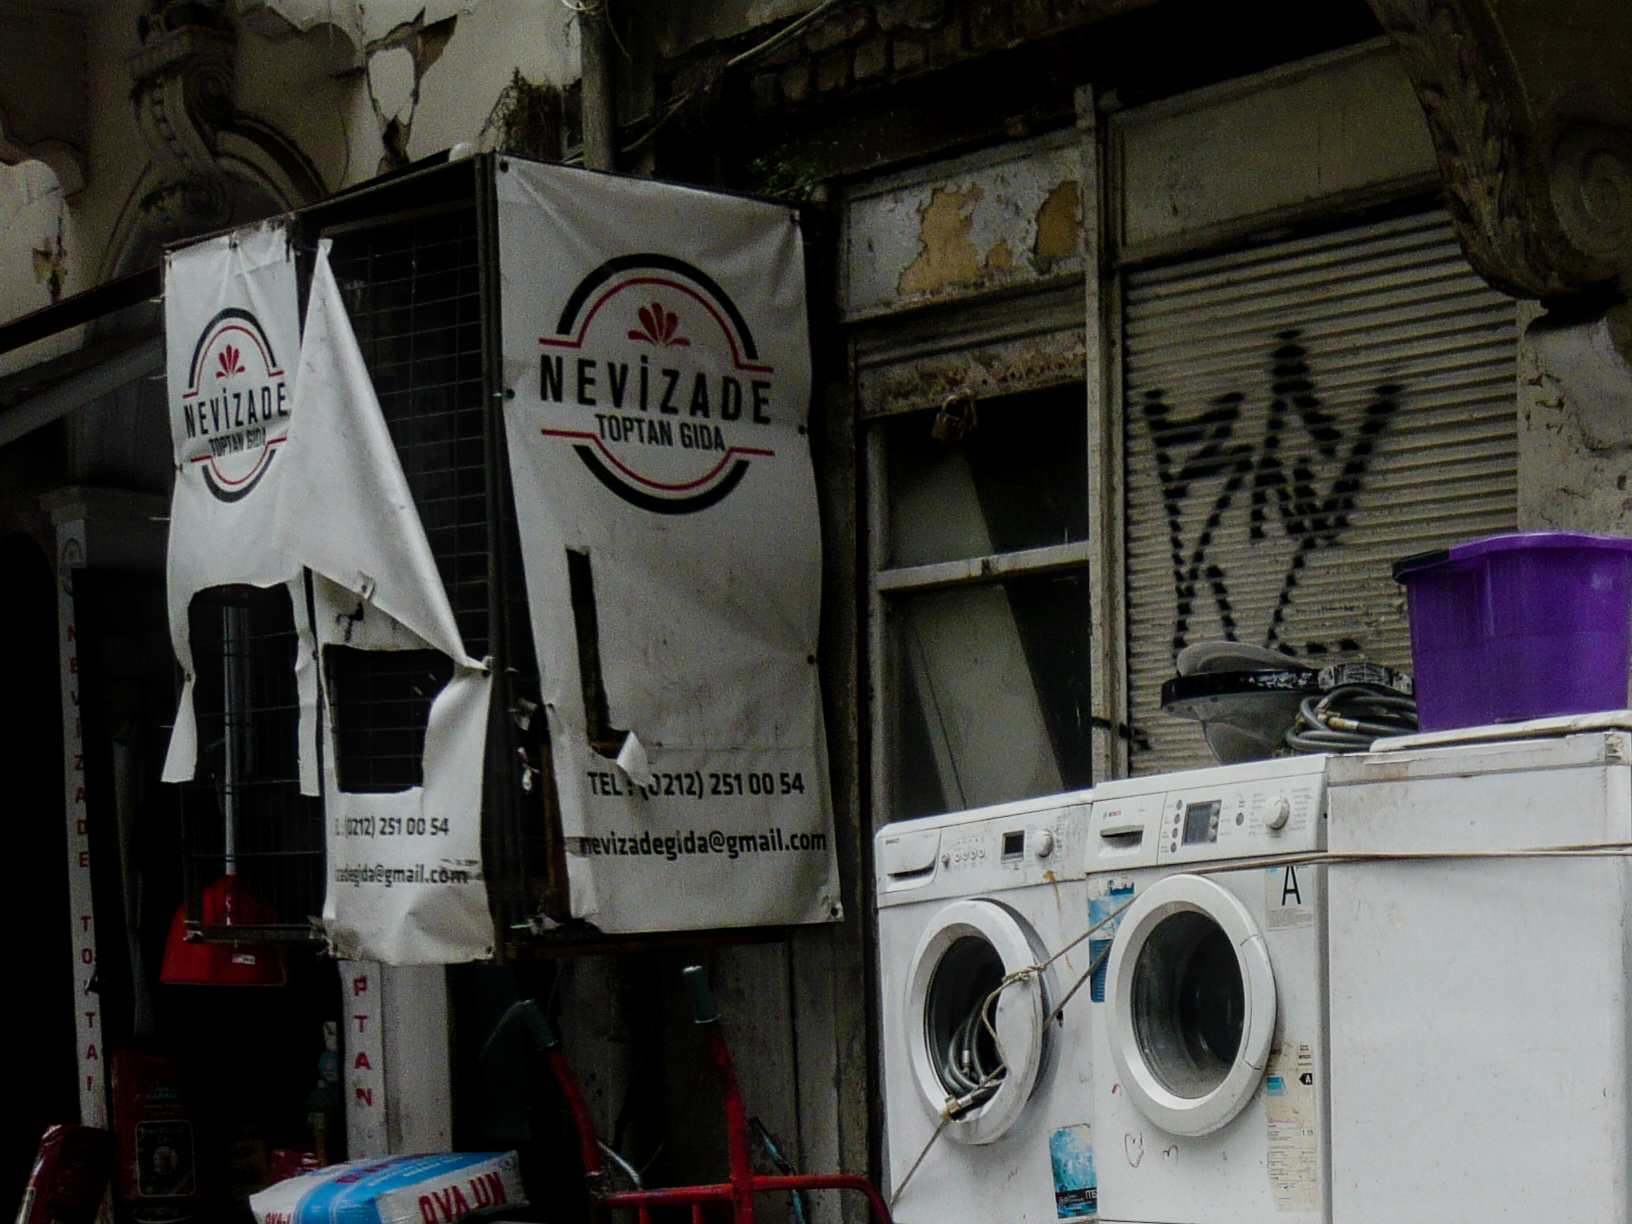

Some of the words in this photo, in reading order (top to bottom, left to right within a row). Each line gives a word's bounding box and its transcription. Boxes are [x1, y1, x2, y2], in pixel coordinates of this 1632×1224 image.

[540, 354, 772, 424] NEVİZADE
[184, 382, 288, 438] NEVİZADE
[595, 413, 673, 447] TOPTAN
[680, 421, 726, 451] GIDA
[588, 771, 623, 796] TEL
[709, 772, 743, 796] 251
[749, 772, 775, 795] 00
[780, 772, 805, 795] 54
[379, 817, 402, 836] 251
[406, 817, 426, 836] 00
[430, 817, 450, 836] 54
[579, 828, 828, 861] nevizadegida@gmail.com
[1281, 865, 1302, 906] A
